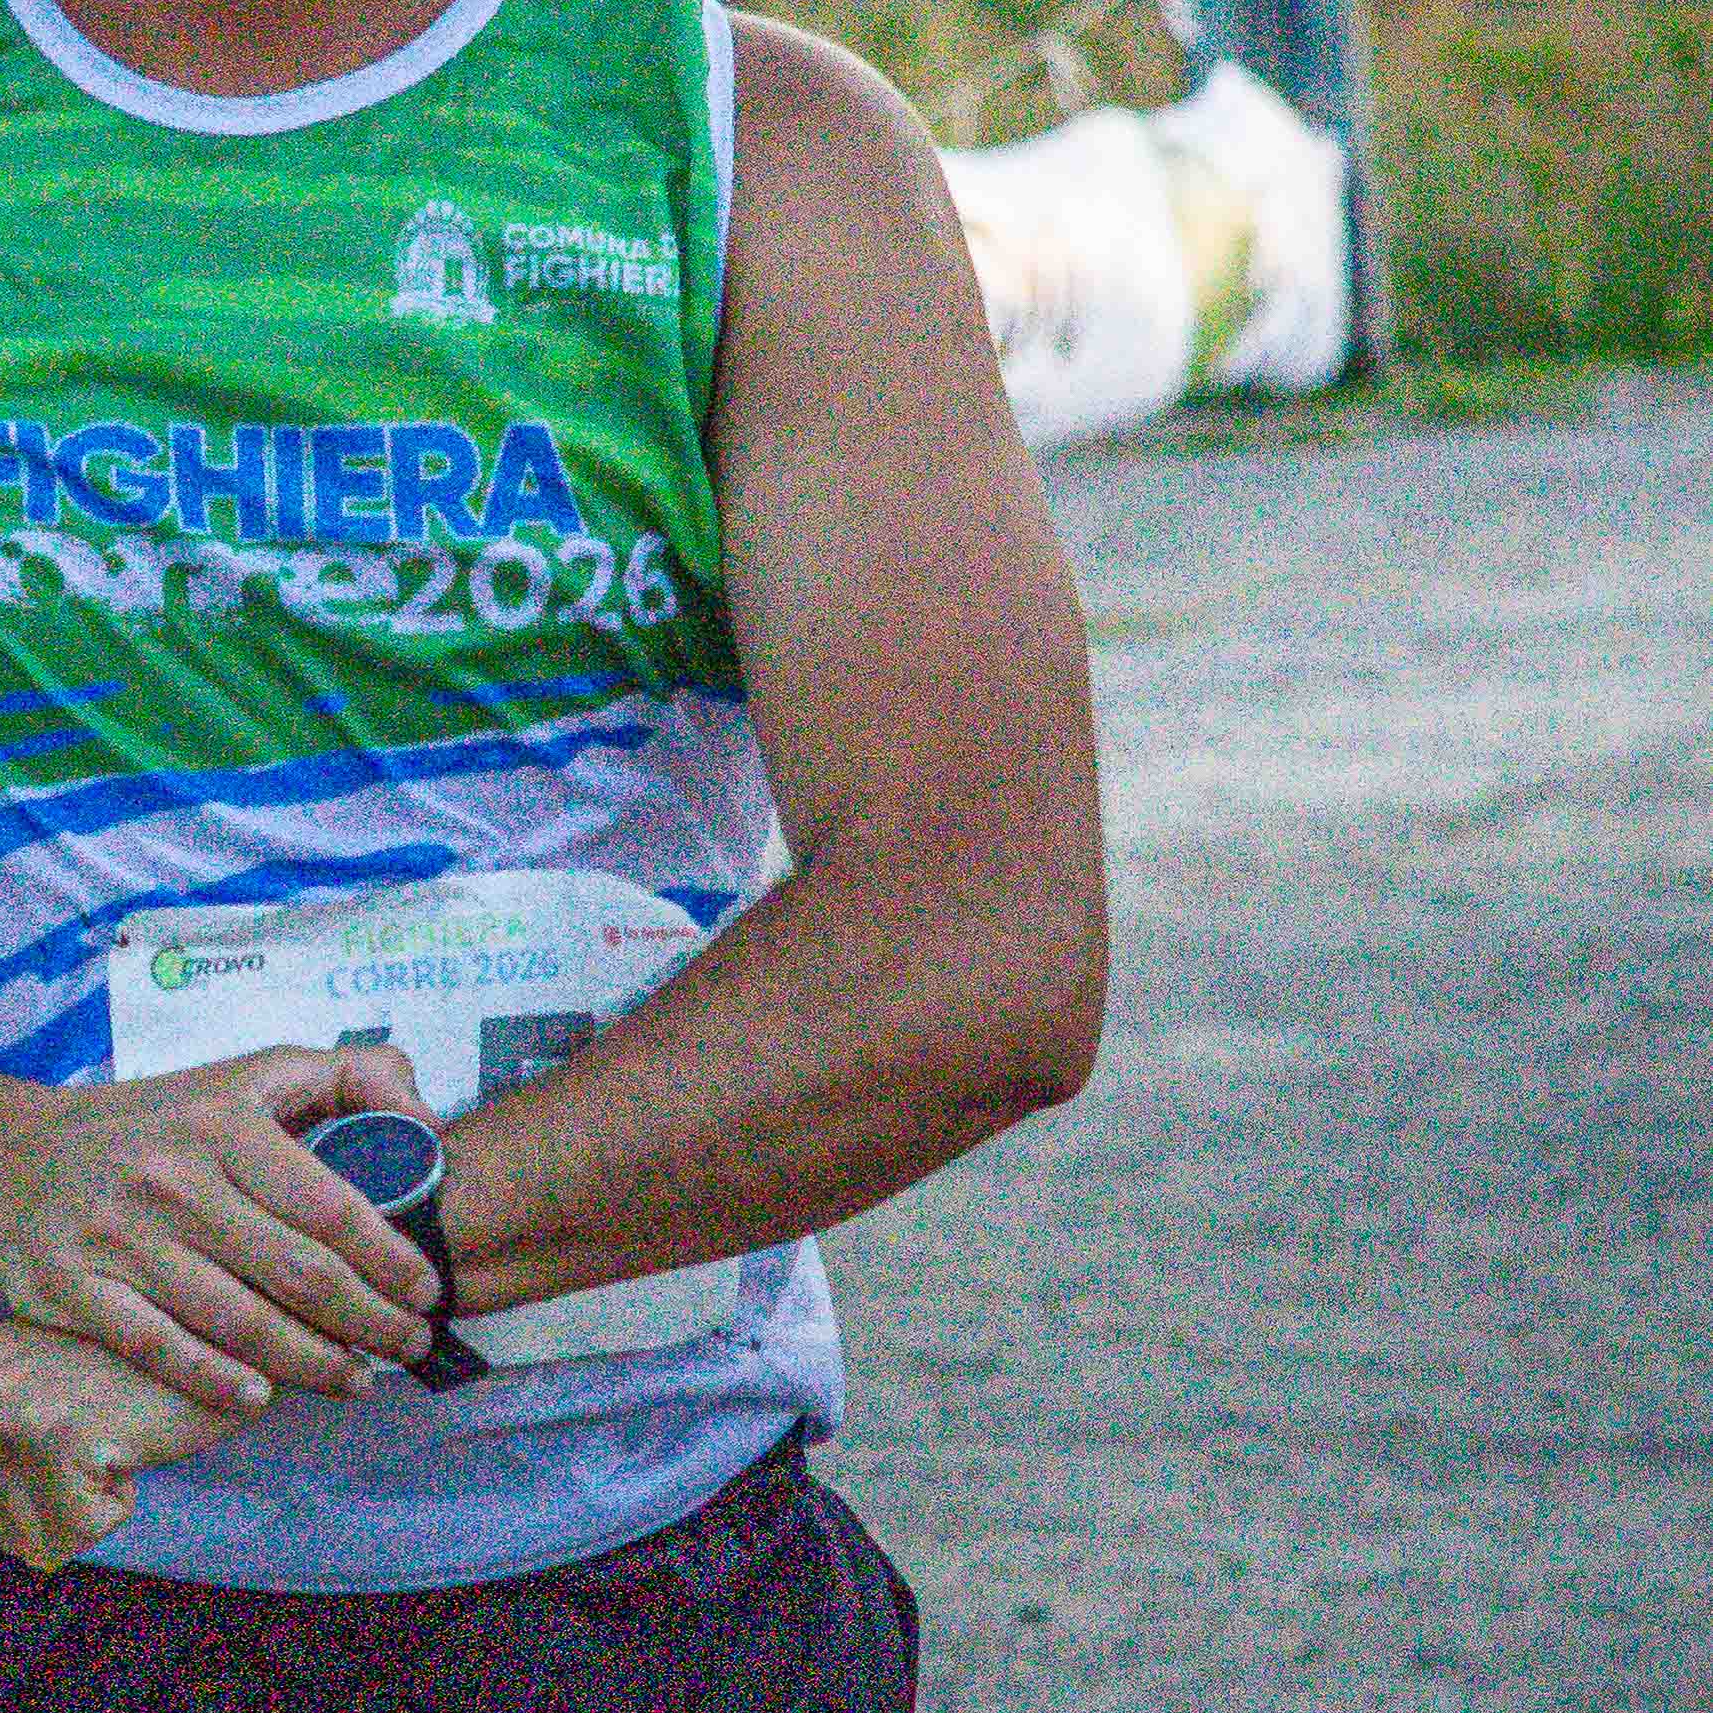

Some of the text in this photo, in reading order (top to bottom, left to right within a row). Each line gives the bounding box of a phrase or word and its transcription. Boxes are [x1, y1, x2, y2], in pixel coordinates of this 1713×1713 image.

[503, 222, 651, 260] COMUNA
[325, 946, 561, 999] CORRE 2026
